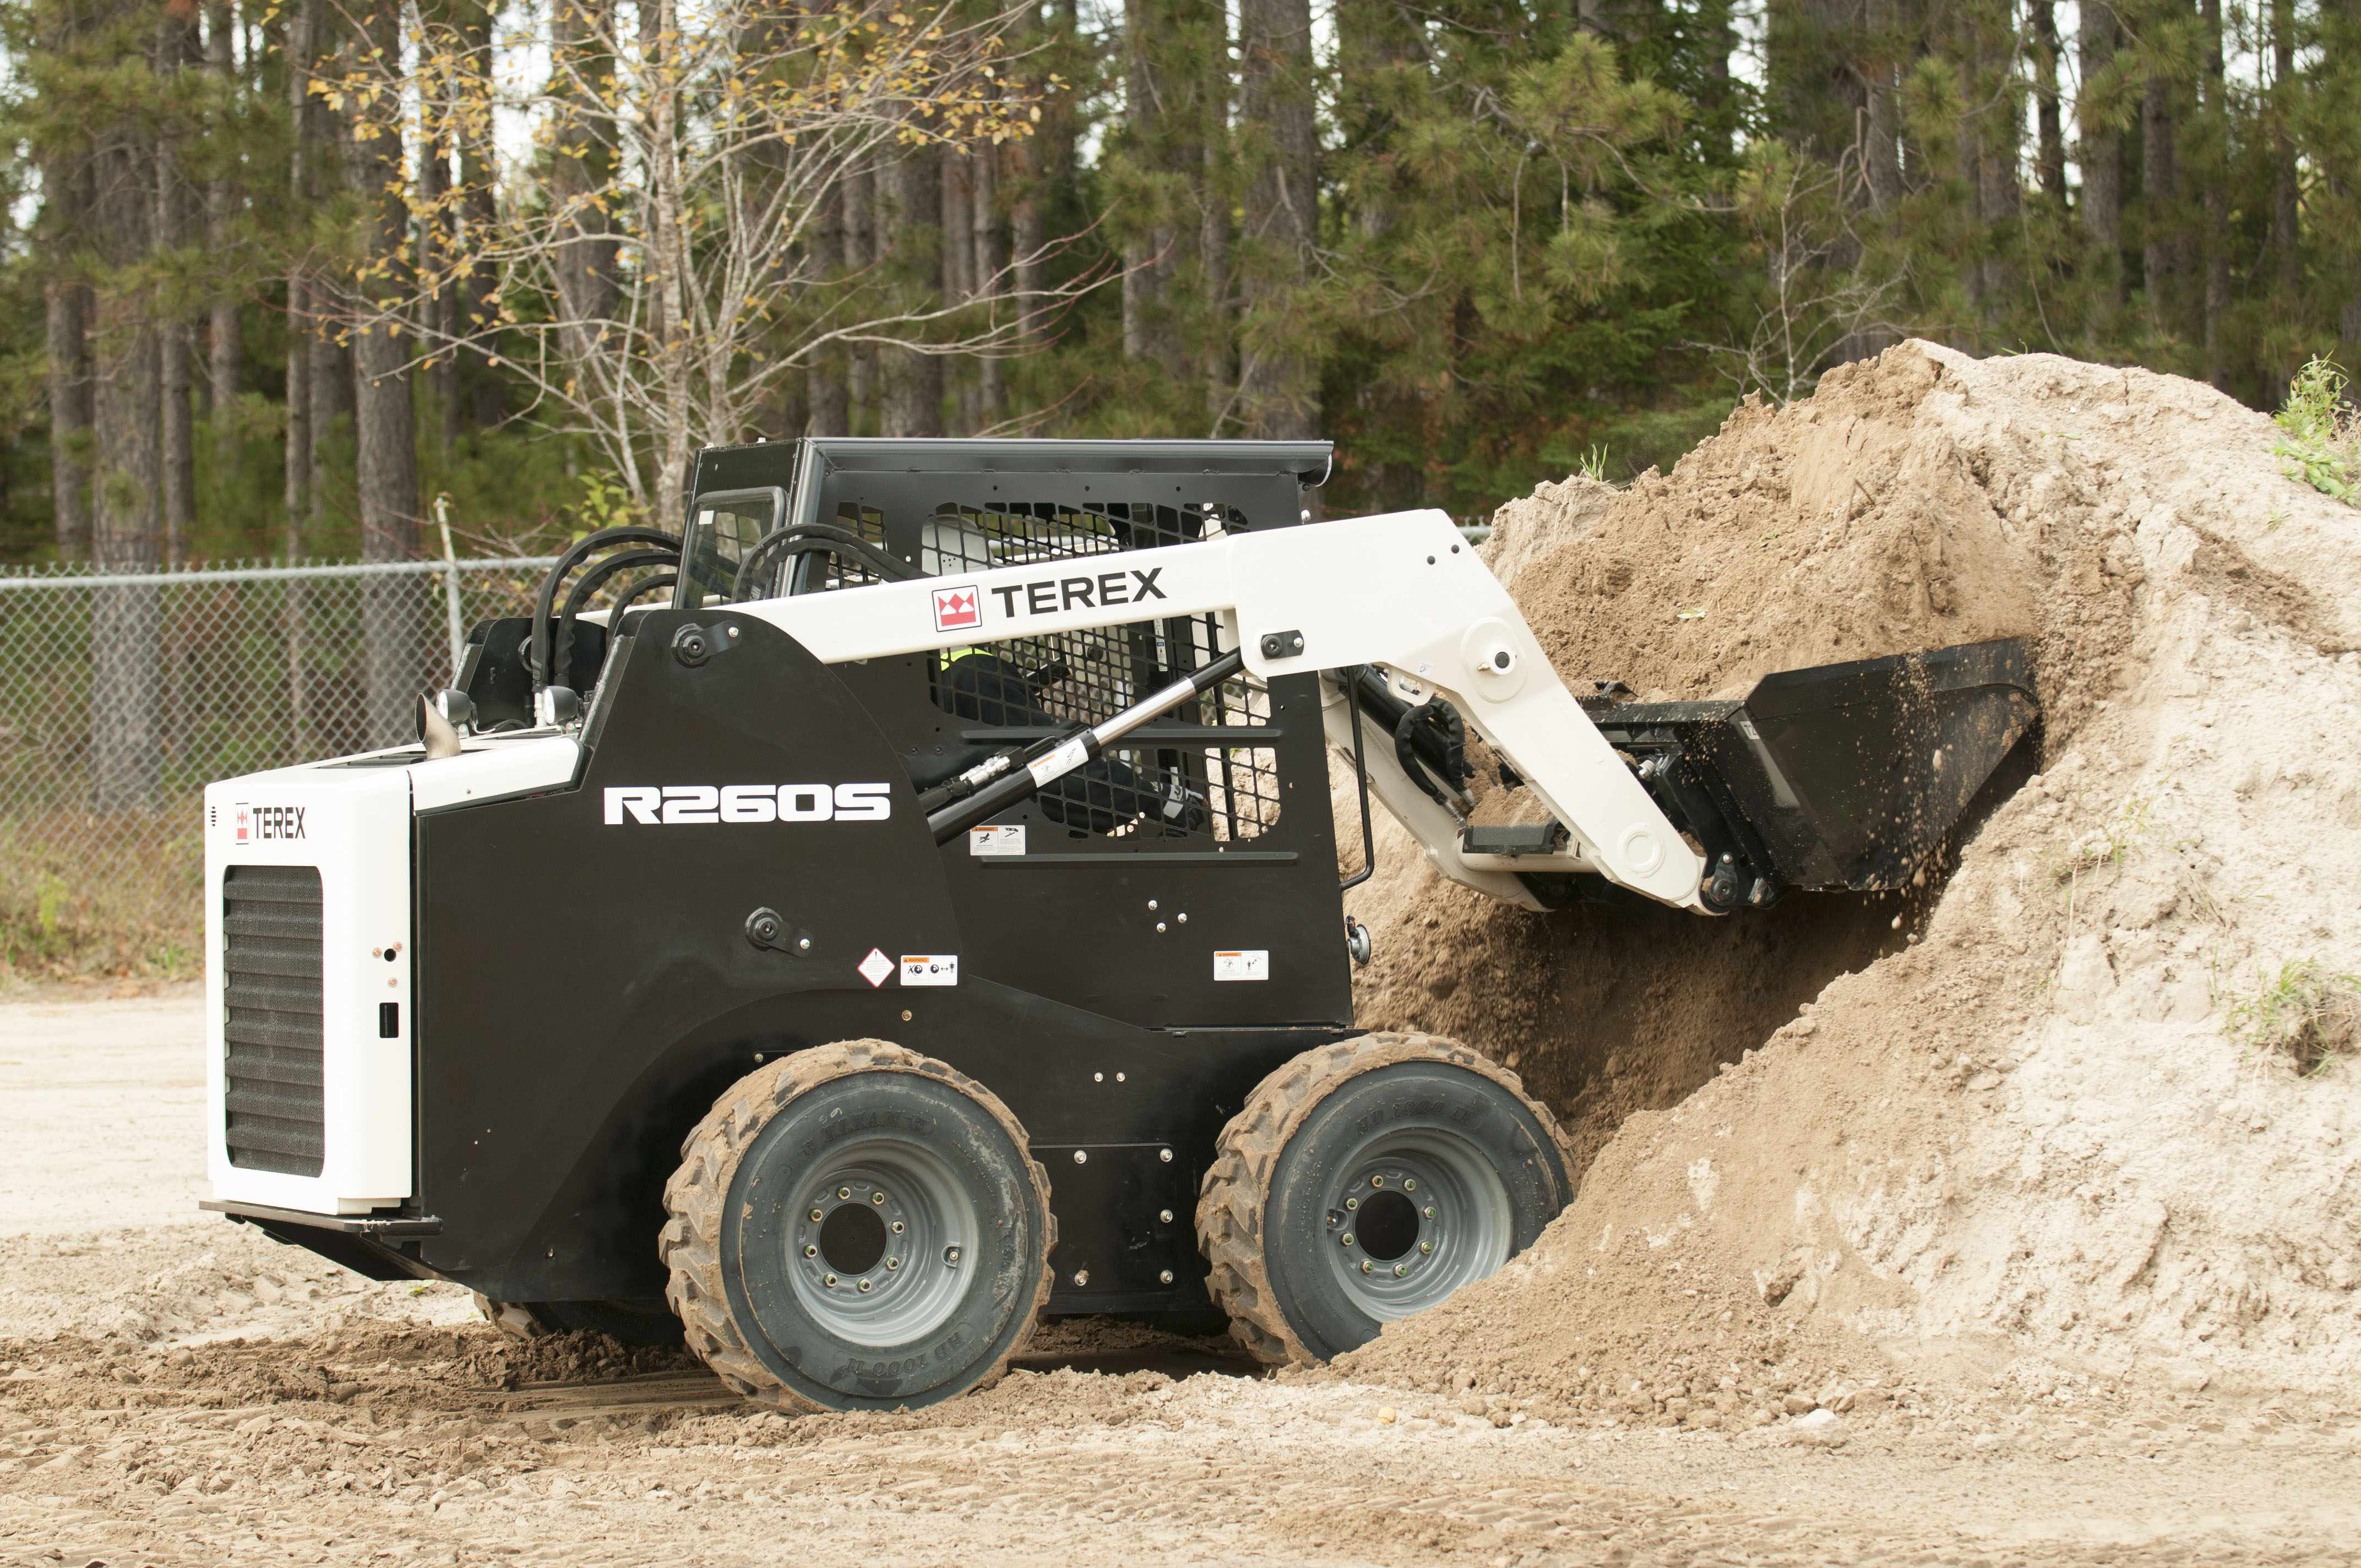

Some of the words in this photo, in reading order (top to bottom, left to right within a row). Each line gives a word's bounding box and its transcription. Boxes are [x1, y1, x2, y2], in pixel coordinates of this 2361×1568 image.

[991, 567, 1167, 618] TEREX
[253, 807, 306, 839] TEREX
[604, 783, 890, 824] R260S
